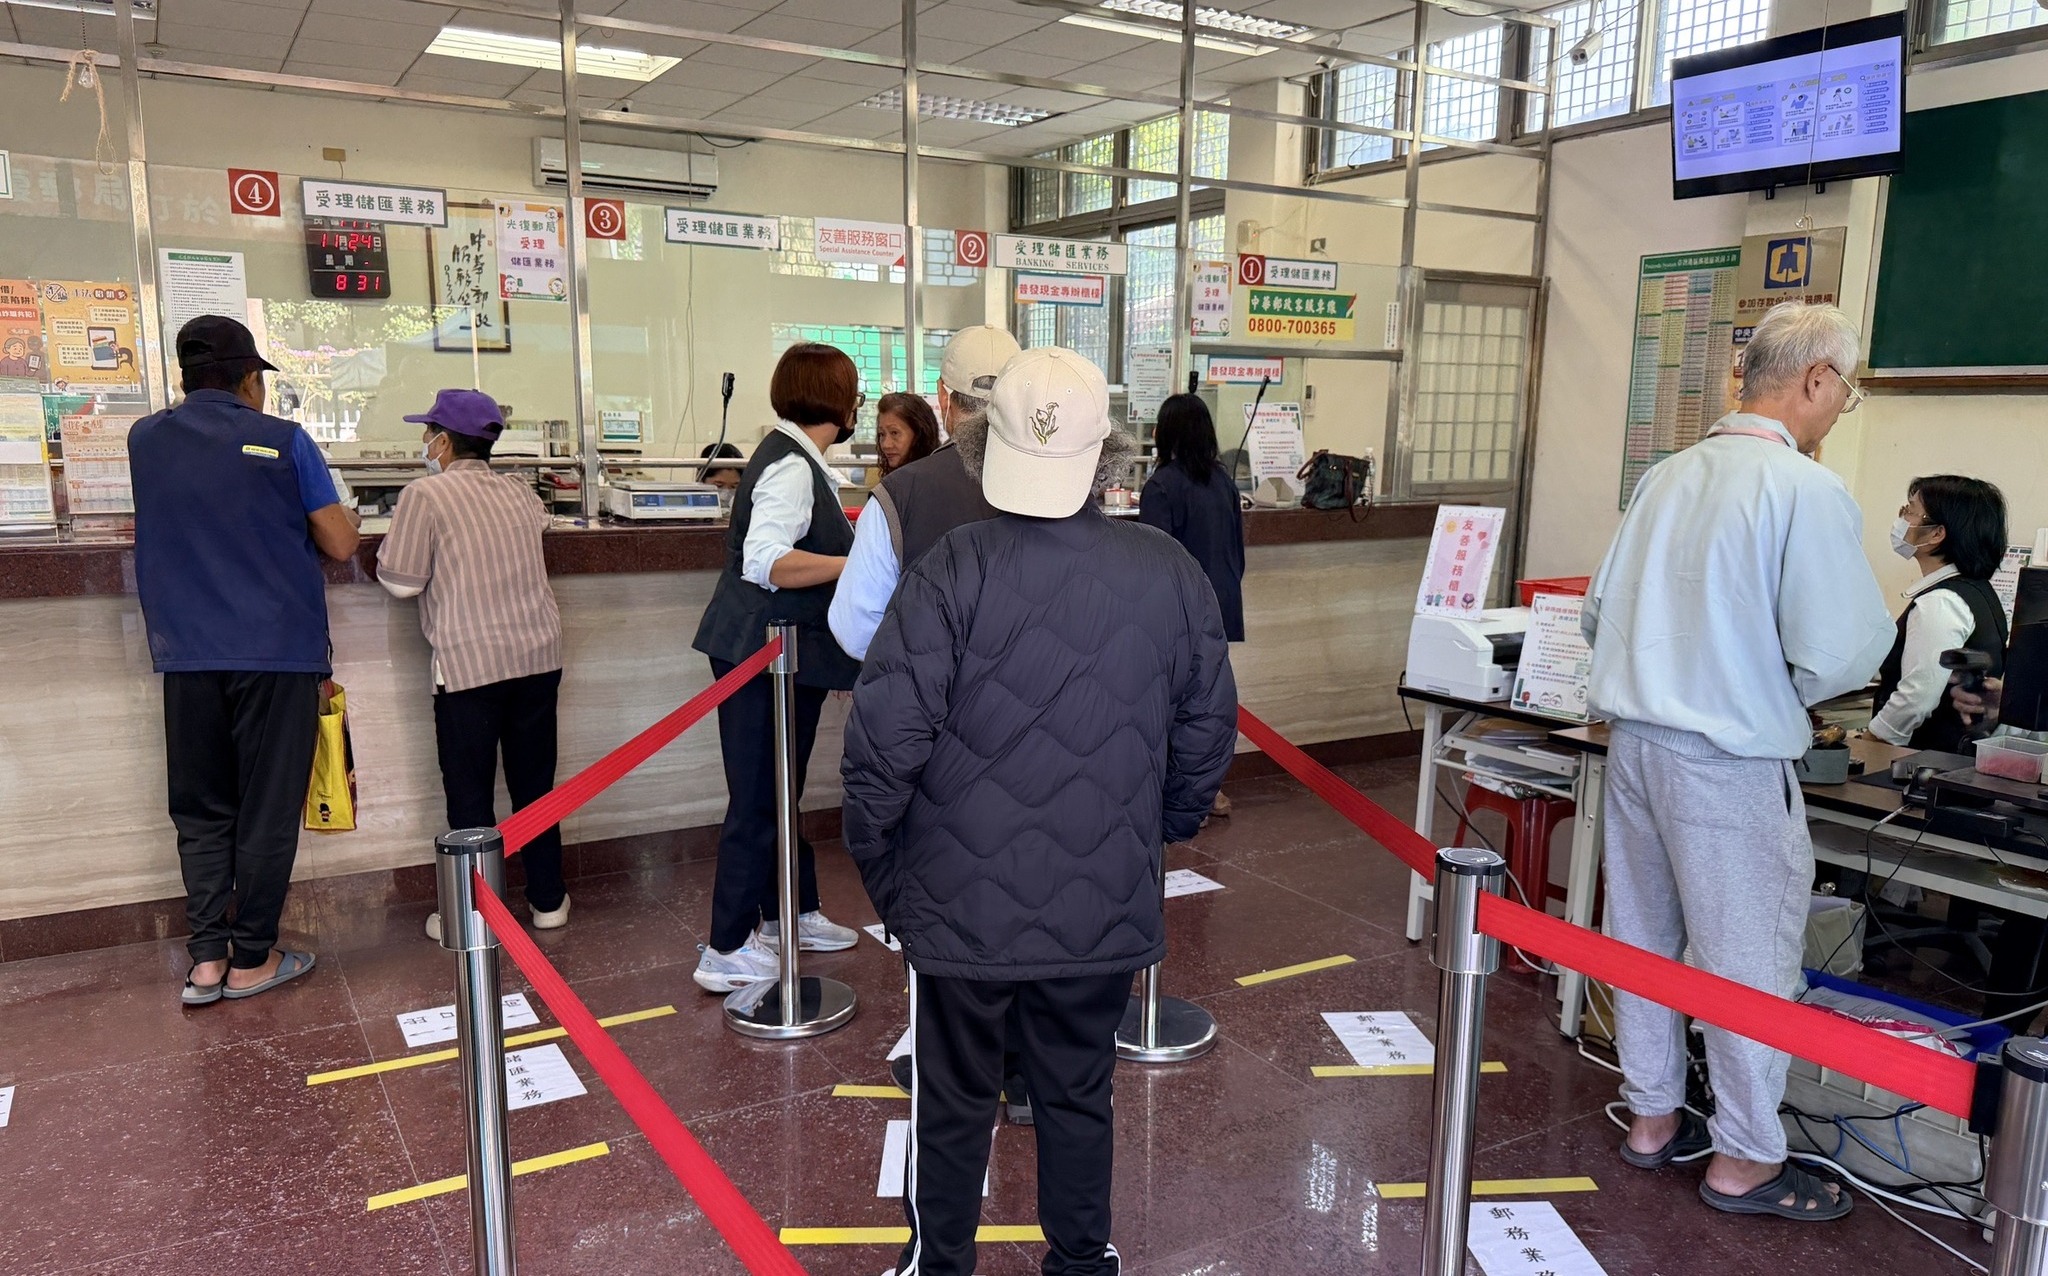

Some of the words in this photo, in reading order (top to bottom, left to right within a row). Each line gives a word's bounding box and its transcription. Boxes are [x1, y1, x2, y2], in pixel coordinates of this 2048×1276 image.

[316, 190, 435, 215] 受理儲匯業務
[506, 218, 556, 233] 光復郵局
[676, 217, 772, 240] 受理儲匯業務
[520, 236, 545, 250] 受理
[819, 227, 902, 248] 友善服務窗口
[819, 245, 840, 254] Special
[841, 247, 871, 256] Assistance
[872, 249, 895, 257] Counter
[1014, 239, 1109, 260] 受理儲匯業務
[511, 257, 555, 269] 儲匯業務
[1015, 257, 1054, 268] BANKING
[1066, 261, 1109, 271] SERVICES
[1248, 317, 1336, 335] 0800-700365
